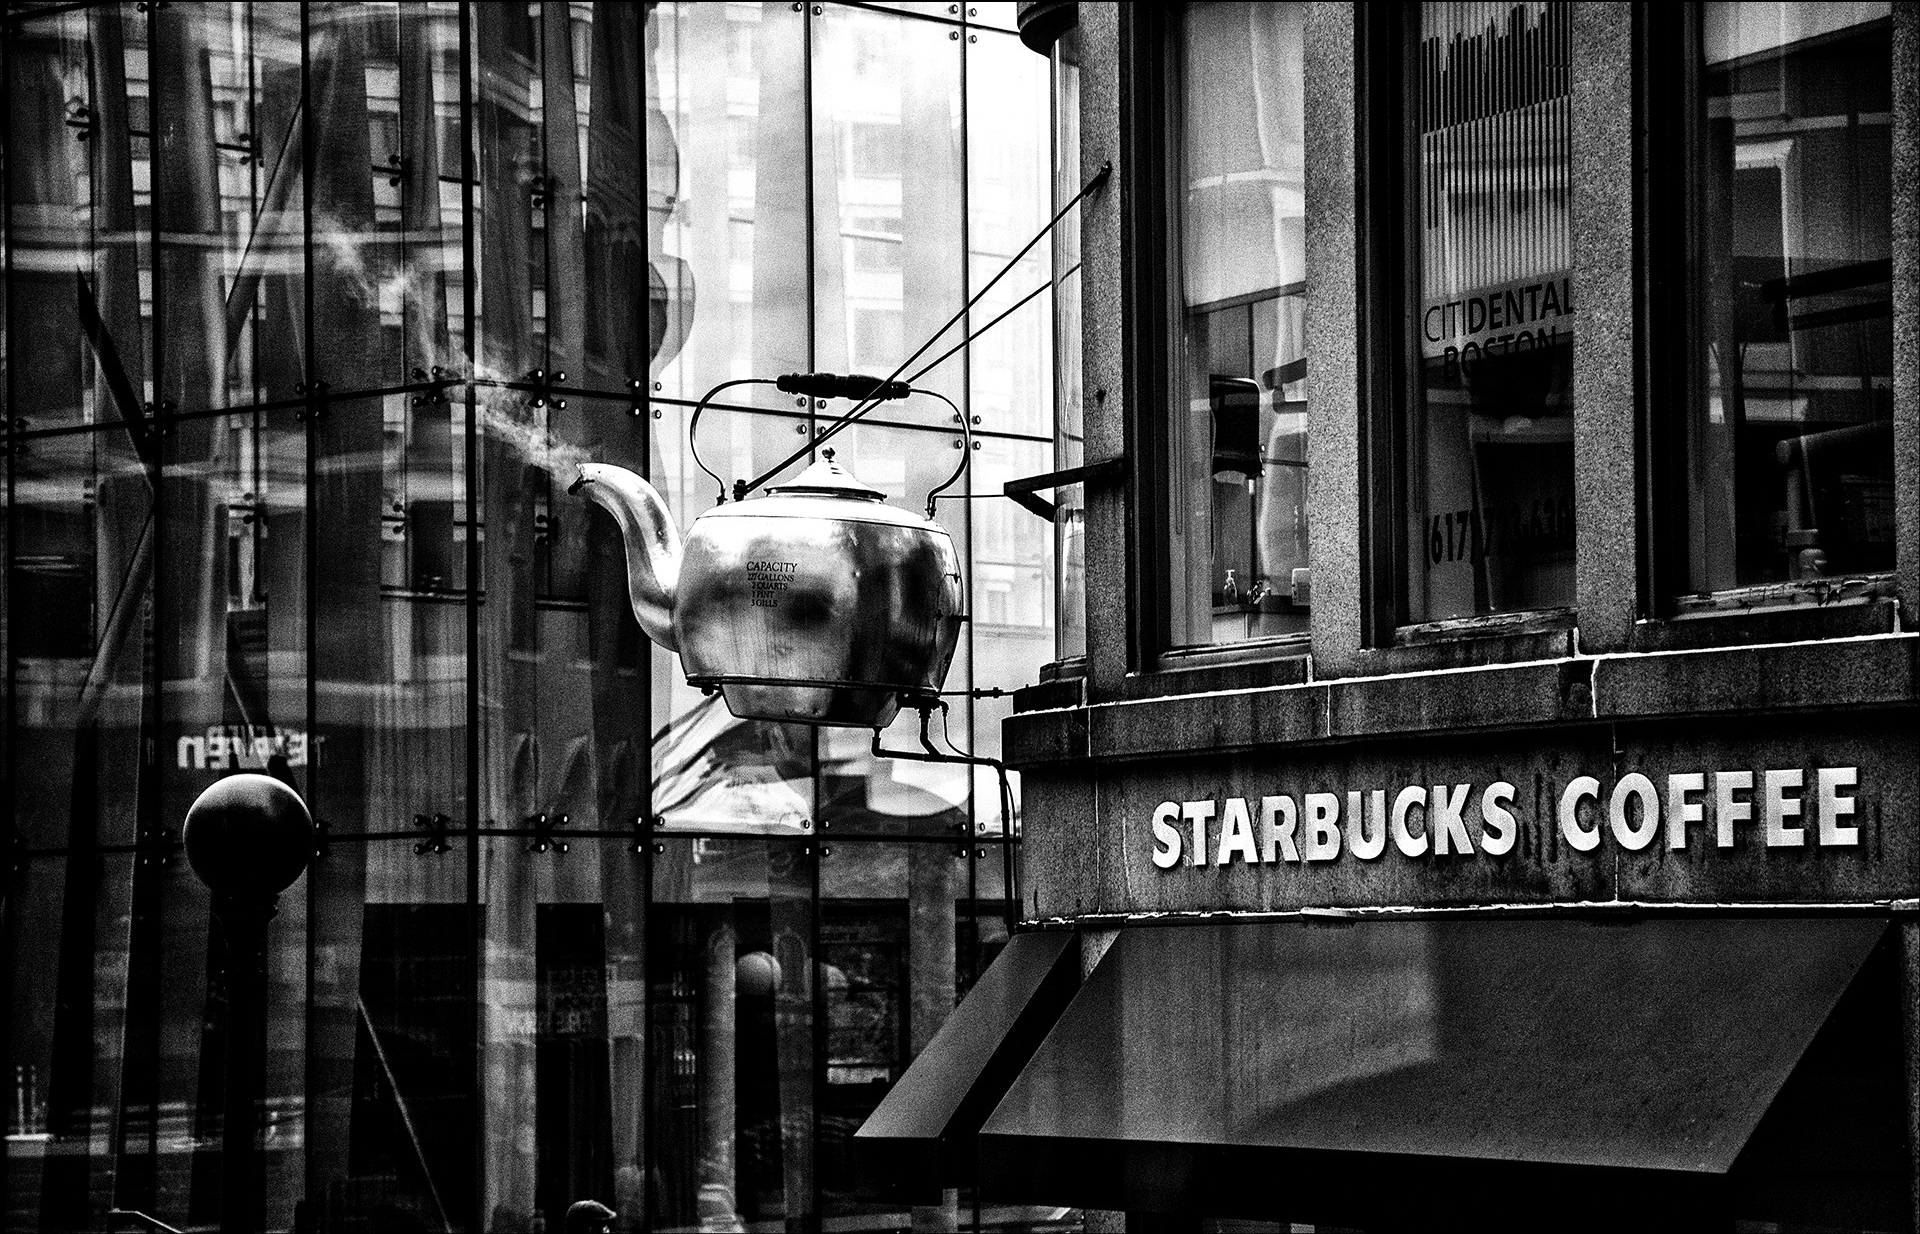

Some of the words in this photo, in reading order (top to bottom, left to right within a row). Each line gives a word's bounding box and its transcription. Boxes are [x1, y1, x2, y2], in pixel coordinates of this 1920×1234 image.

[1424, 278, 1574, 342] CITIDENTAL
[746, 561, 798, 573] CAPACITY
[758, 573, 795, 582] GALLONS
[757, 582, 788, 591] QUARTS
[756, 590, 775, 598] PINT
[756, 599, 778, 607] GILLS
[1151, 780, 1517, 869] STARBUCKS
[1559, 766, 1859, 852] COFFEE
